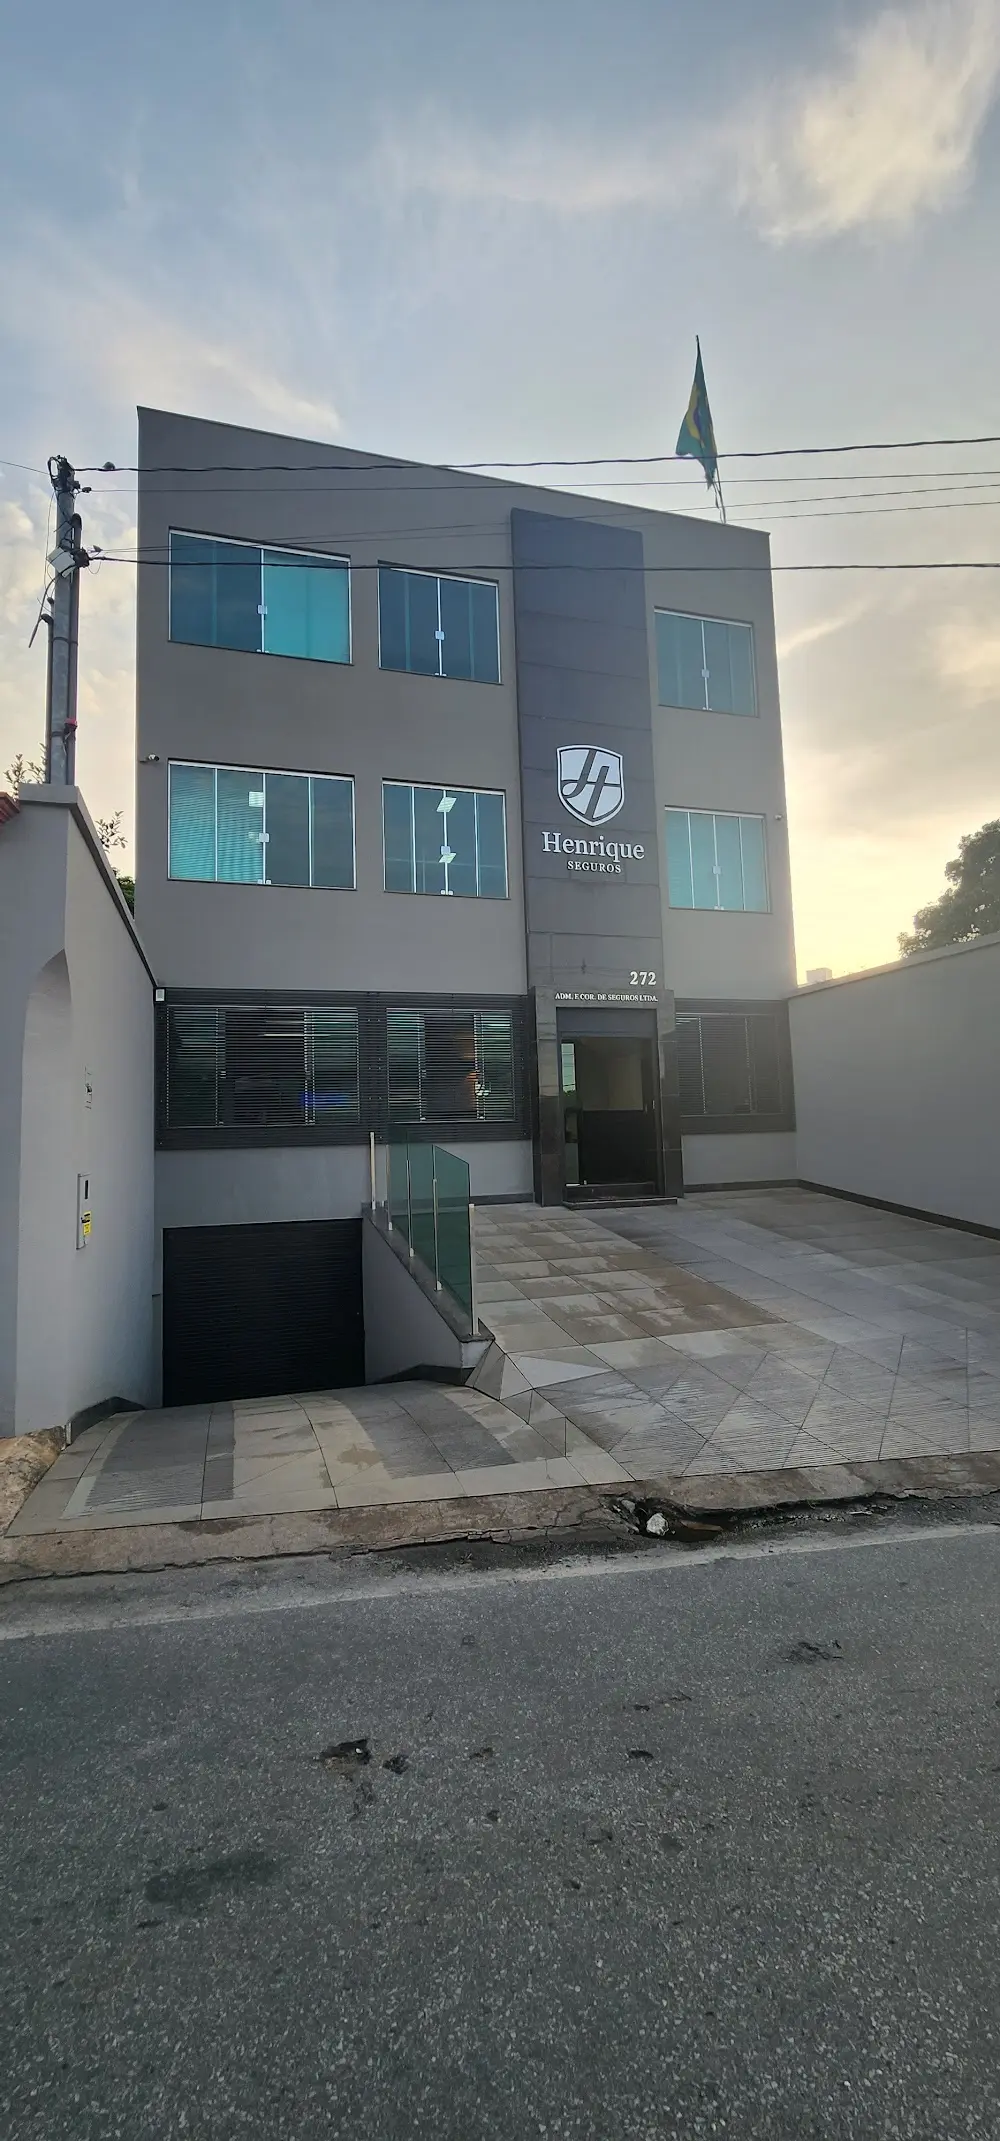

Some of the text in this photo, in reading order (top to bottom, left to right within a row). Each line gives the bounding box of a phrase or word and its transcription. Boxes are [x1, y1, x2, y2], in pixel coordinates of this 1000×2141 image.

[541, 831, 645, 862] Henrique
[567, 860, 622, 874] SEGUROS
[629, 971, 657, 986] 272
[555, 992, 574, 1000] ADM.
[597, 993, 608, 1001] DE
[607, 994, 639, 1002] SEGUROS
